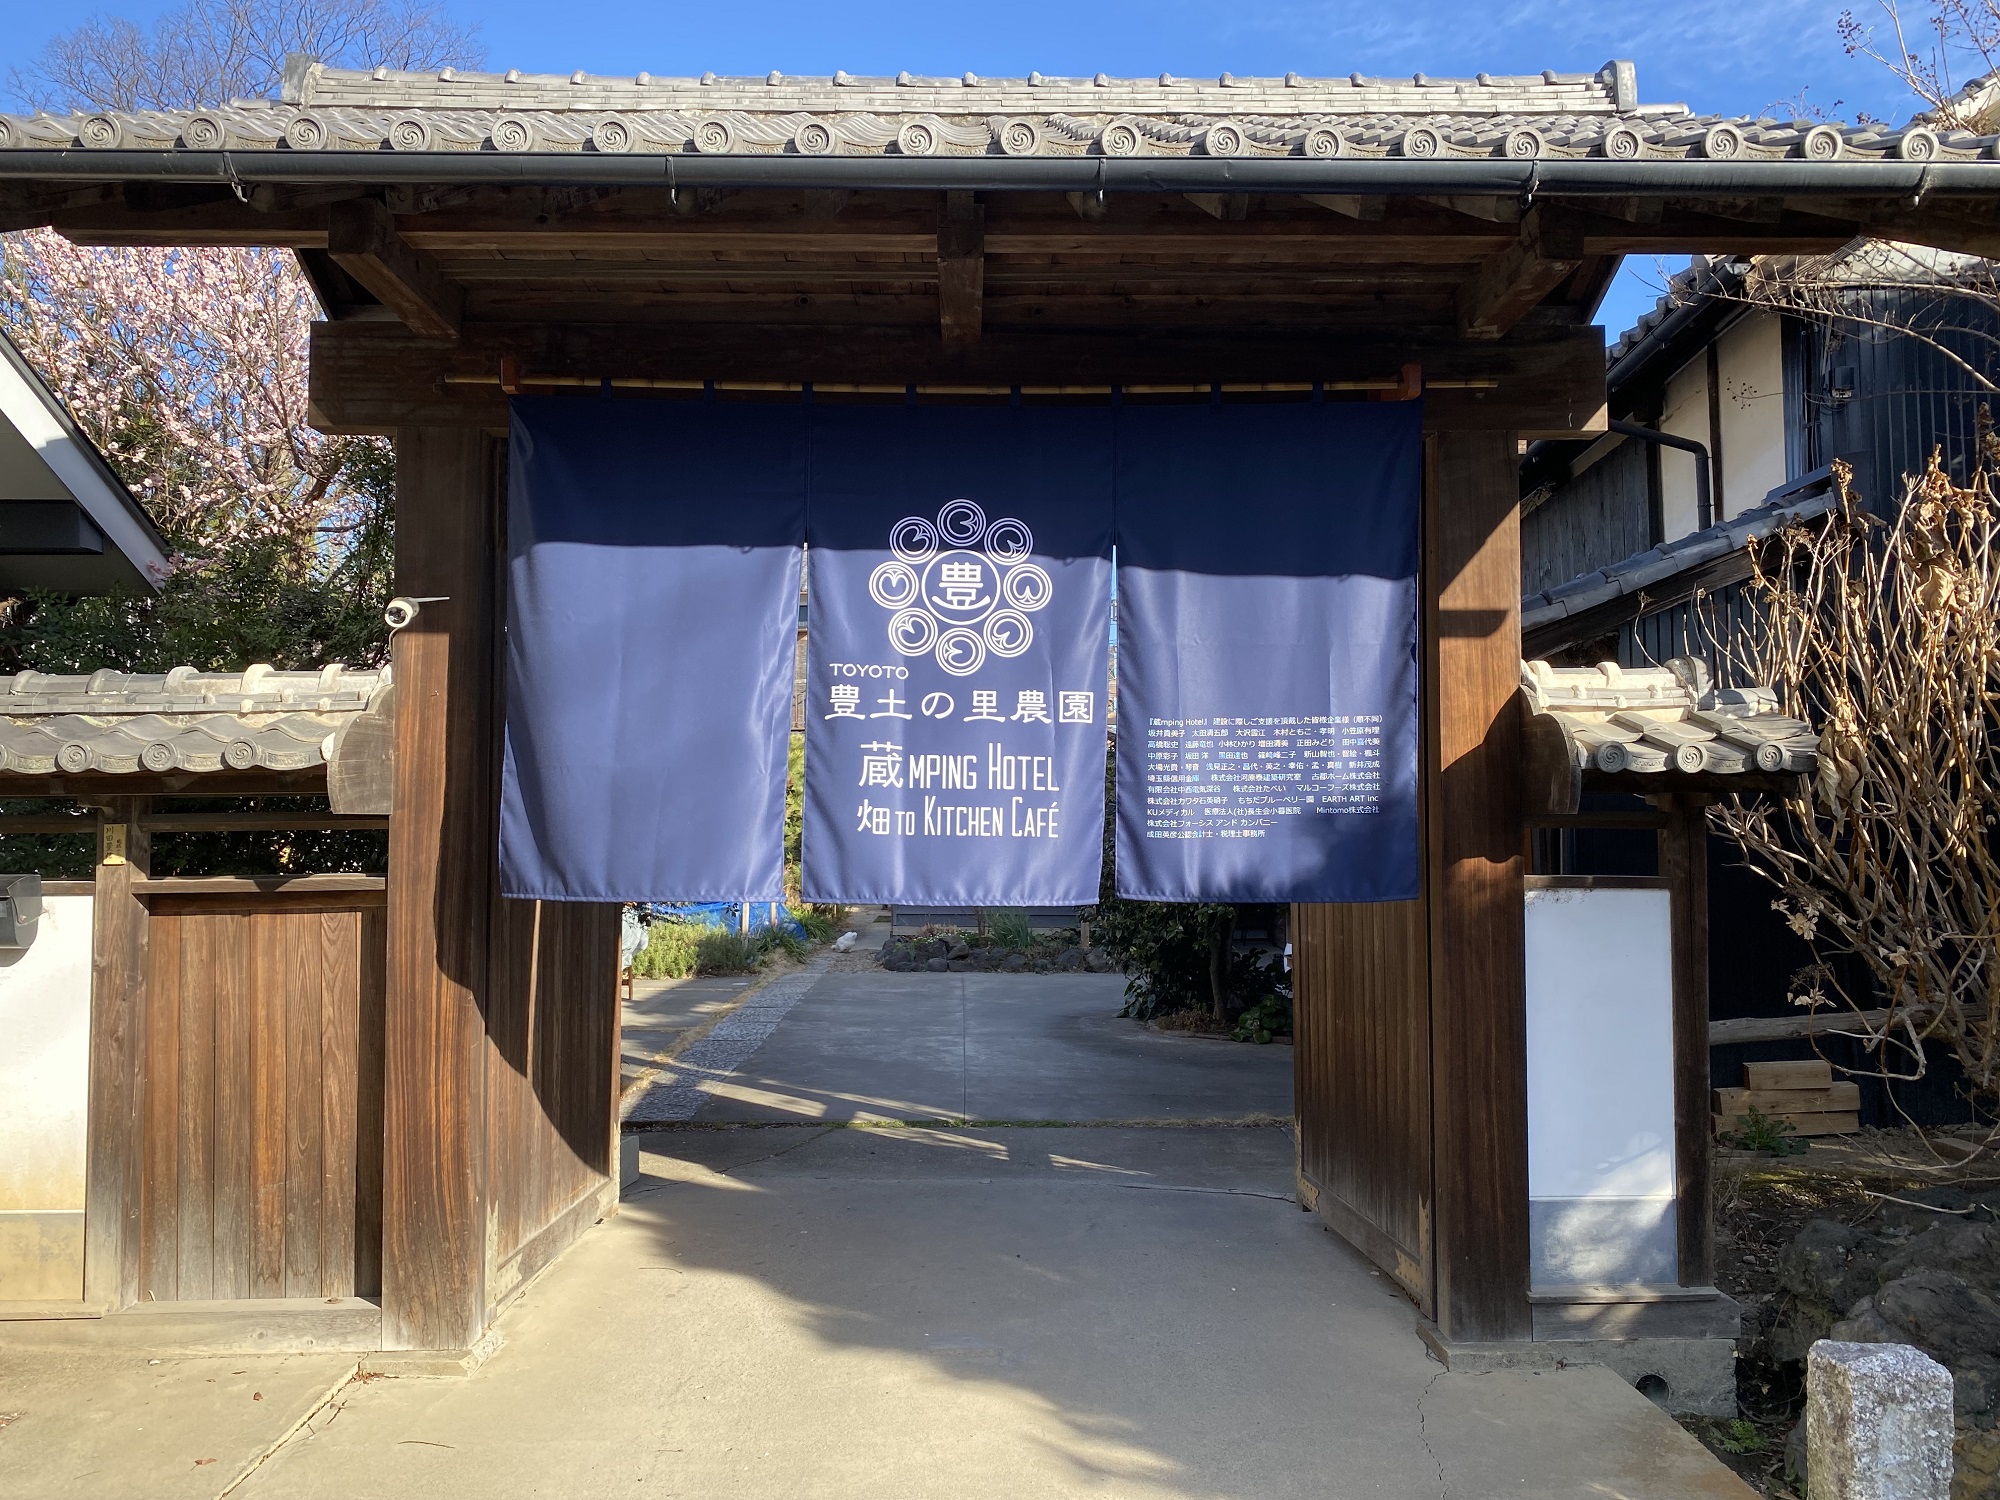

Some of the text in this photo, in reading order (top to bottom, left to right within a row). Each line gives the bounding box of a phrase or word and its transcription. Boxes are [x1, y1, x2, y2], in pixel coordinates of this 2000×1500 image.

[932, 561, 992, 611] 豊
[828, 663, 909, 680] TOYOTO
[824, 683, 1095, 725] 豊土の里農園
[1218, 740, 1256, 749] 小林ひかり
[1296, 738, 1335, 748] 正田みどり
[1321, 795, 1348, 804] EARTH
[1349, 794, 1366, 803] ART
[1146, 808, 1196, 817] KUメディカル
